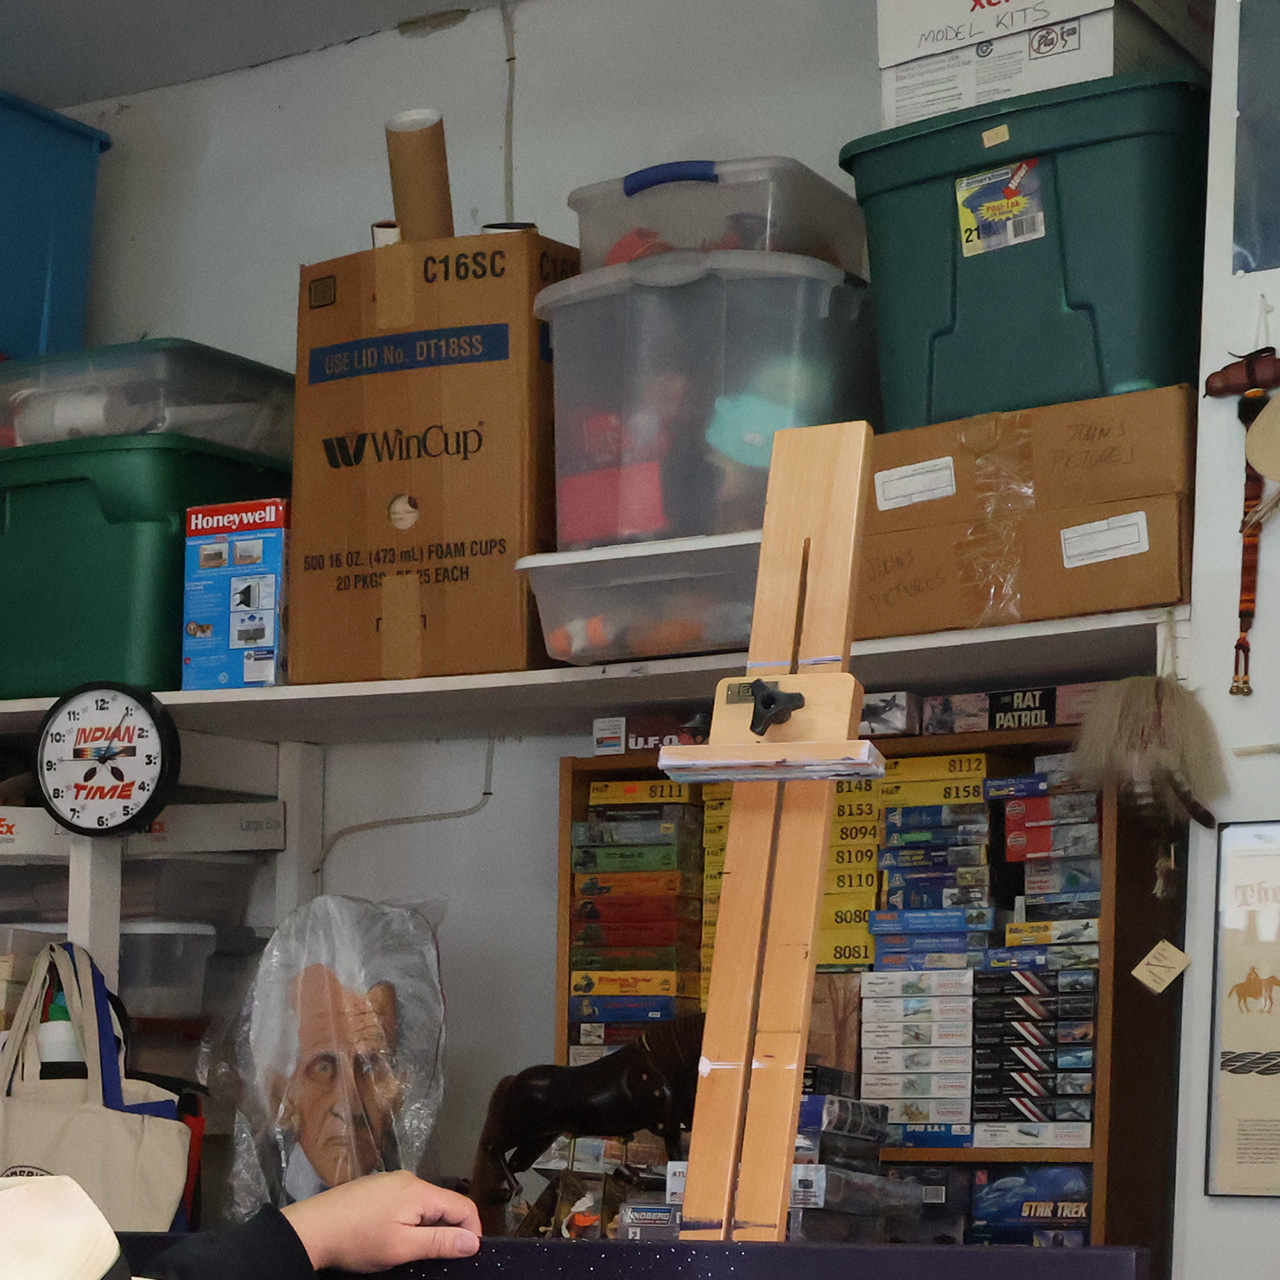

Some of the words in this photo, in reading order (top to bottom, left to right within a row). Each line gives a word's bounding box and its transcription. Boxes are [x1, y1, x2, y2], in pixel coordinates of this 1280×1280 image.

[918, 22, 985, 49] MODEL
[995, 1, 1051, 30] KITS
[423, 250, 506, 284] C16SC
[354, 347, 378, 370] LID
[383, 343, 410, 366] No.
[370, 424, 484, 463] WinCup
[190, 504, 278, 532] Honeywell
[427, 541, 466, 561] FOAM
[469, 537, 507, 556] CUPS
[434, 565, 470, 584] EACH
[1013, 690, 1043, 709] RAT
[995, 709, 1048, 730] PATROL
[74, 725, 136, 748] INDIAN
[947, 758, 983, 774] 8112
[72, 780, 136, 801] TIME
[648, 783, 684, 799] 8111
[835, 779, 872, 794] 8148
[943, 784, 981, 800] 8158
[837, 803, 873, 819] 8153
[839, 824, 878, 841] 8094
[835, 848, 874, 865] 8109
[836, 873, 875, 889] 8110
[833, 945, 869, 961] 8081
[1021, 1201, 1054, 1218] STAR
[1056, 1201, 1090, 1218] TREK
